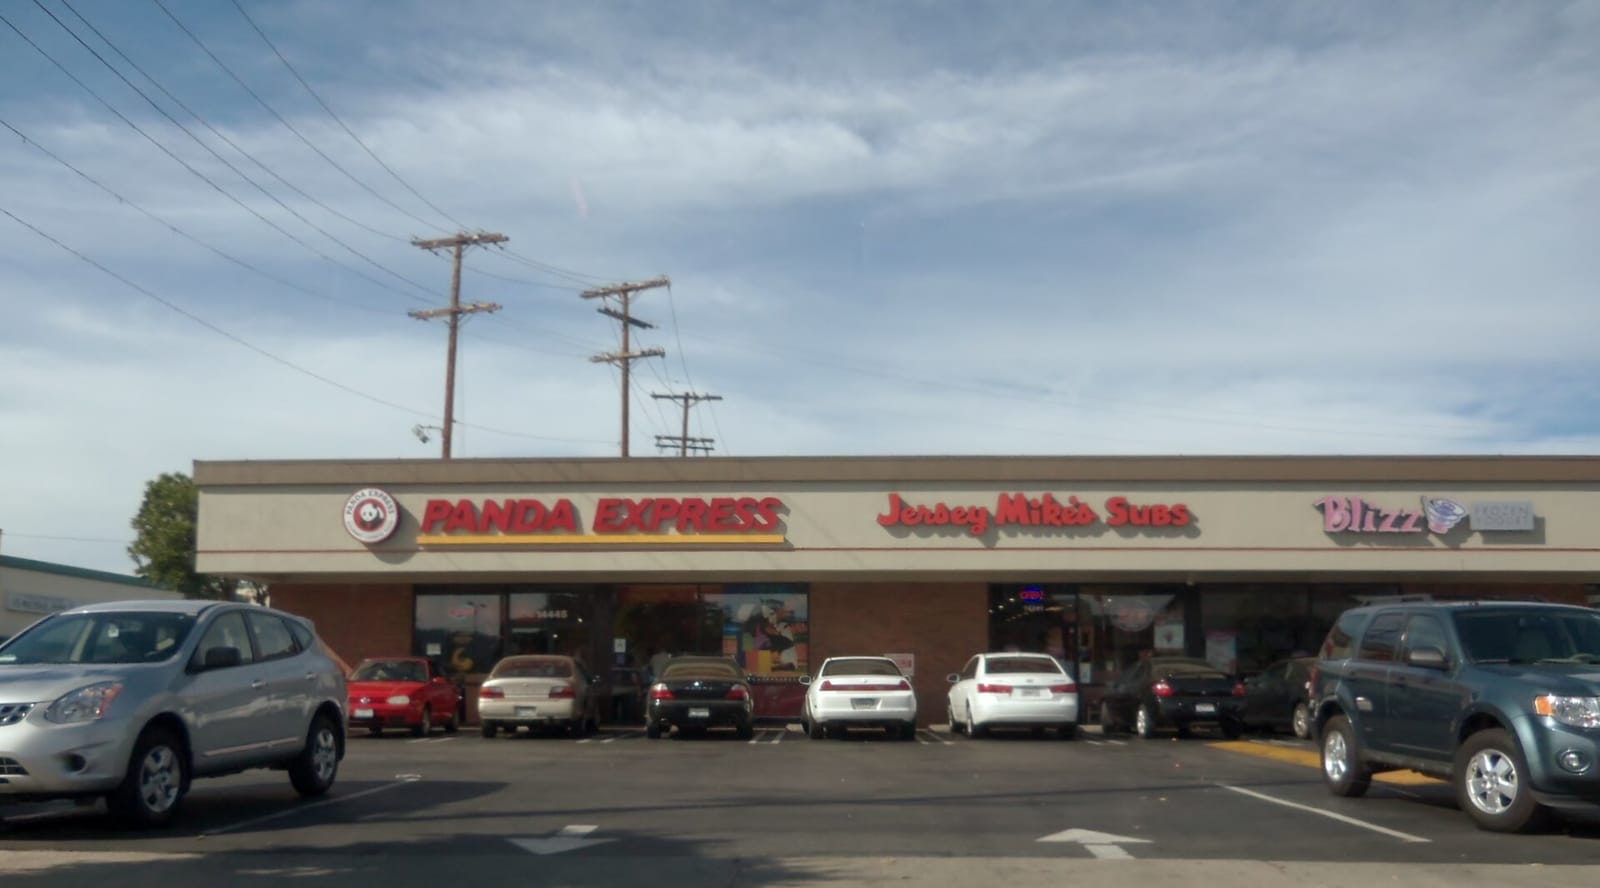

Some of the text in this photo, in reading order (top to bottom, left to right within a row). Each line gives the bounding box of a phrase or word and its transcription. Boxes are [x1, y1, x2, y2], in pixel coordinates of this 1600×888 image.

[420, 499, 577, 534] PANDA
[592, 497, 786, 533] EXPRESS
[876, 492, 988, 536] Jersey
[995, 492, 1097, 527] Mike's
[1312, 496, 1423, 532] Blizz
